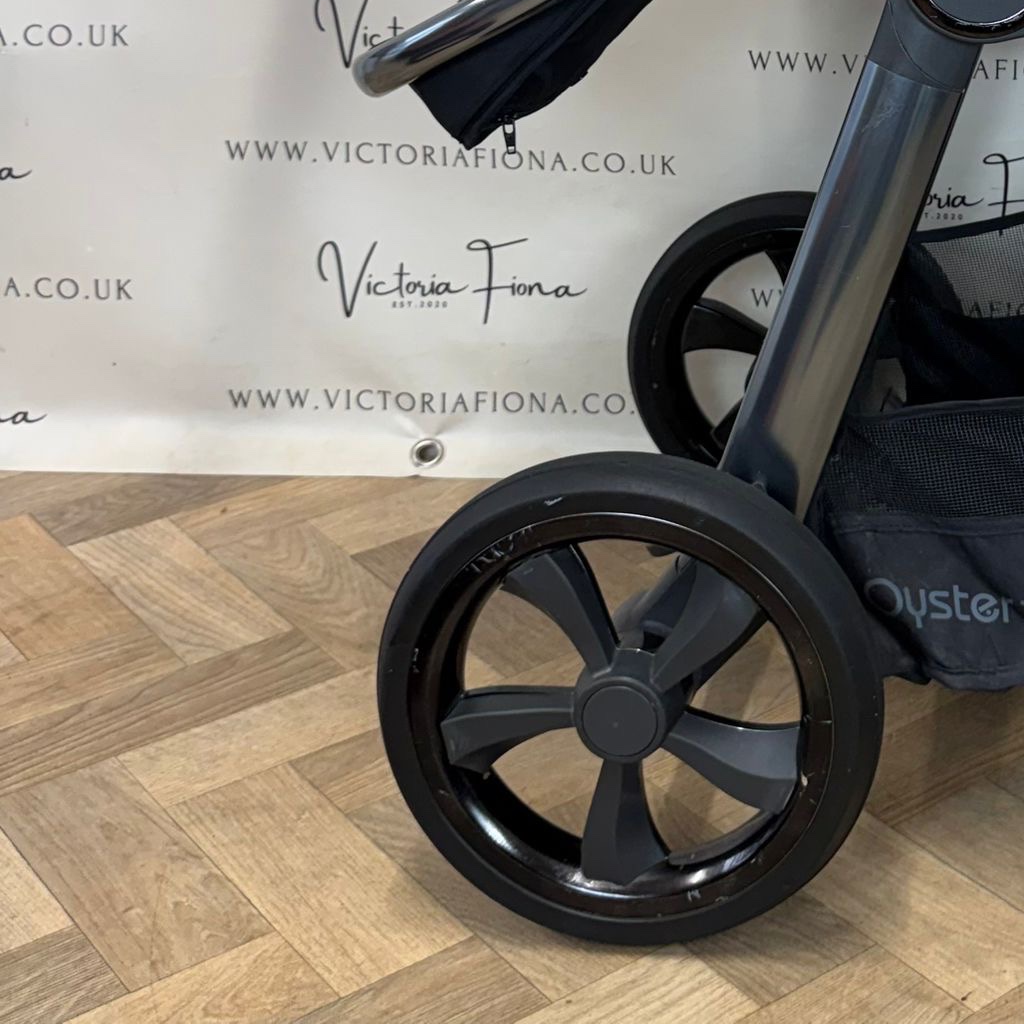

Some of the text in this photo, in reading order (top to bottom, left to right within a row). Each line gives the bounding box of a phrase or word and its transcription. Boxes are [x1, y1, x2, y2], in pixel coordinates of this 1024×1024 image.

[225, 140, 676, 175] WWW.VICTORIAFIONA.CO.UK
[317, 238, 587, 325] Victoria Fiona
[228, 388, 634, 415] WWW.VICTORIAFIONA.CO.
